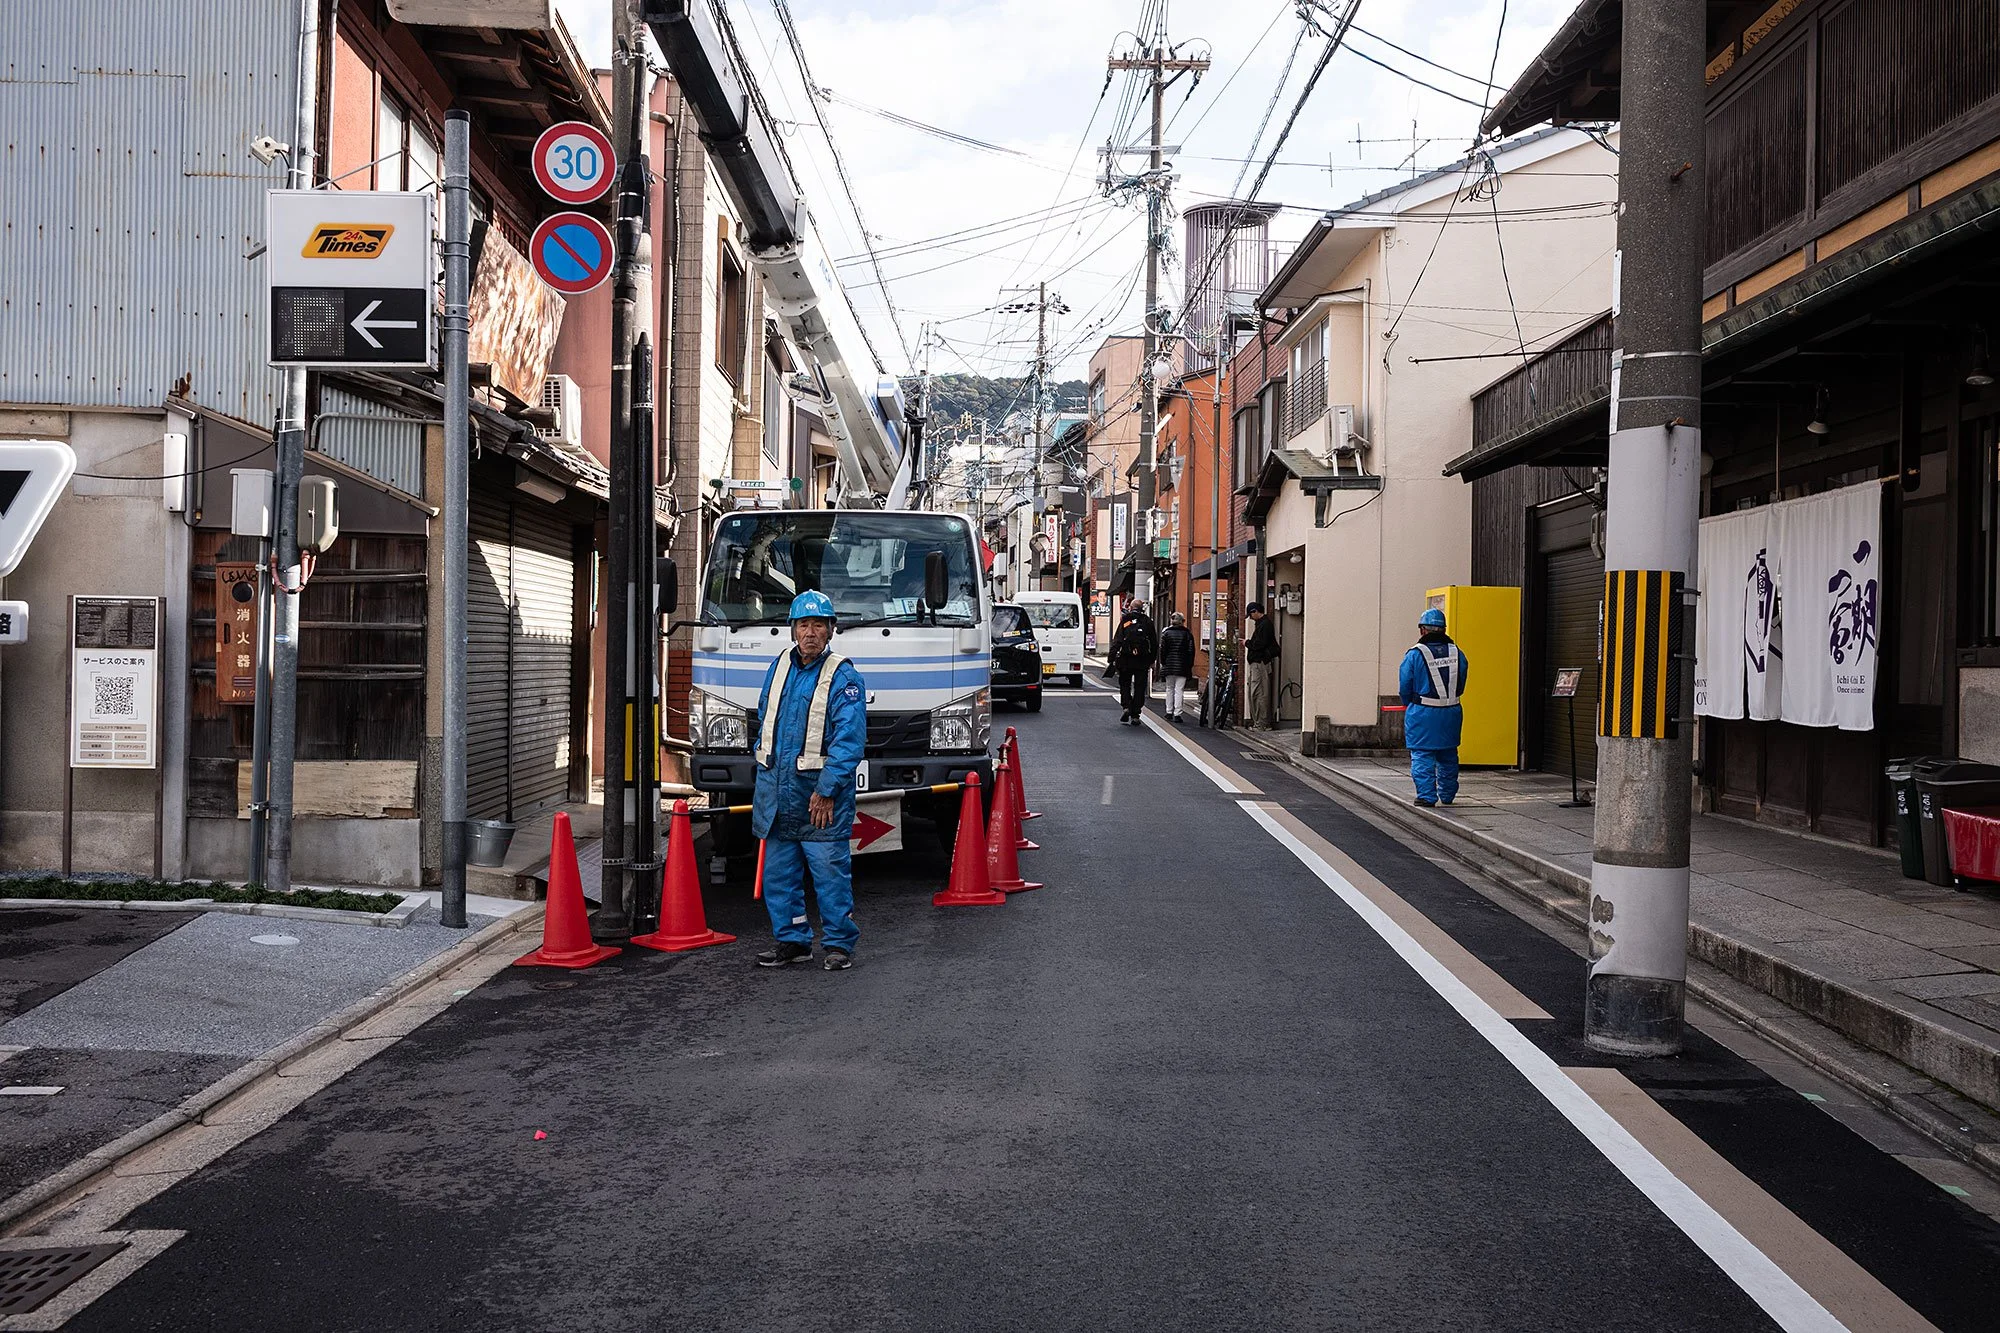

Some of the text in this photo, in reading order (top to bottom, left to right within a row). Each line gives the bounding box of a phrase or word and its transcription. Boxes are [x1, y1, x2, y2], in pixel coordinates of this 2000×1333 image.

[552, 144, 597, 181] 30
[343, 231, 363, 241] 24h
[316, 234, 379, 254] Times
[236, 608, 251, 668] 消火器
[728, 642, 762, 650] ELF
[83, 656, 146, 666] サービスのご案内
